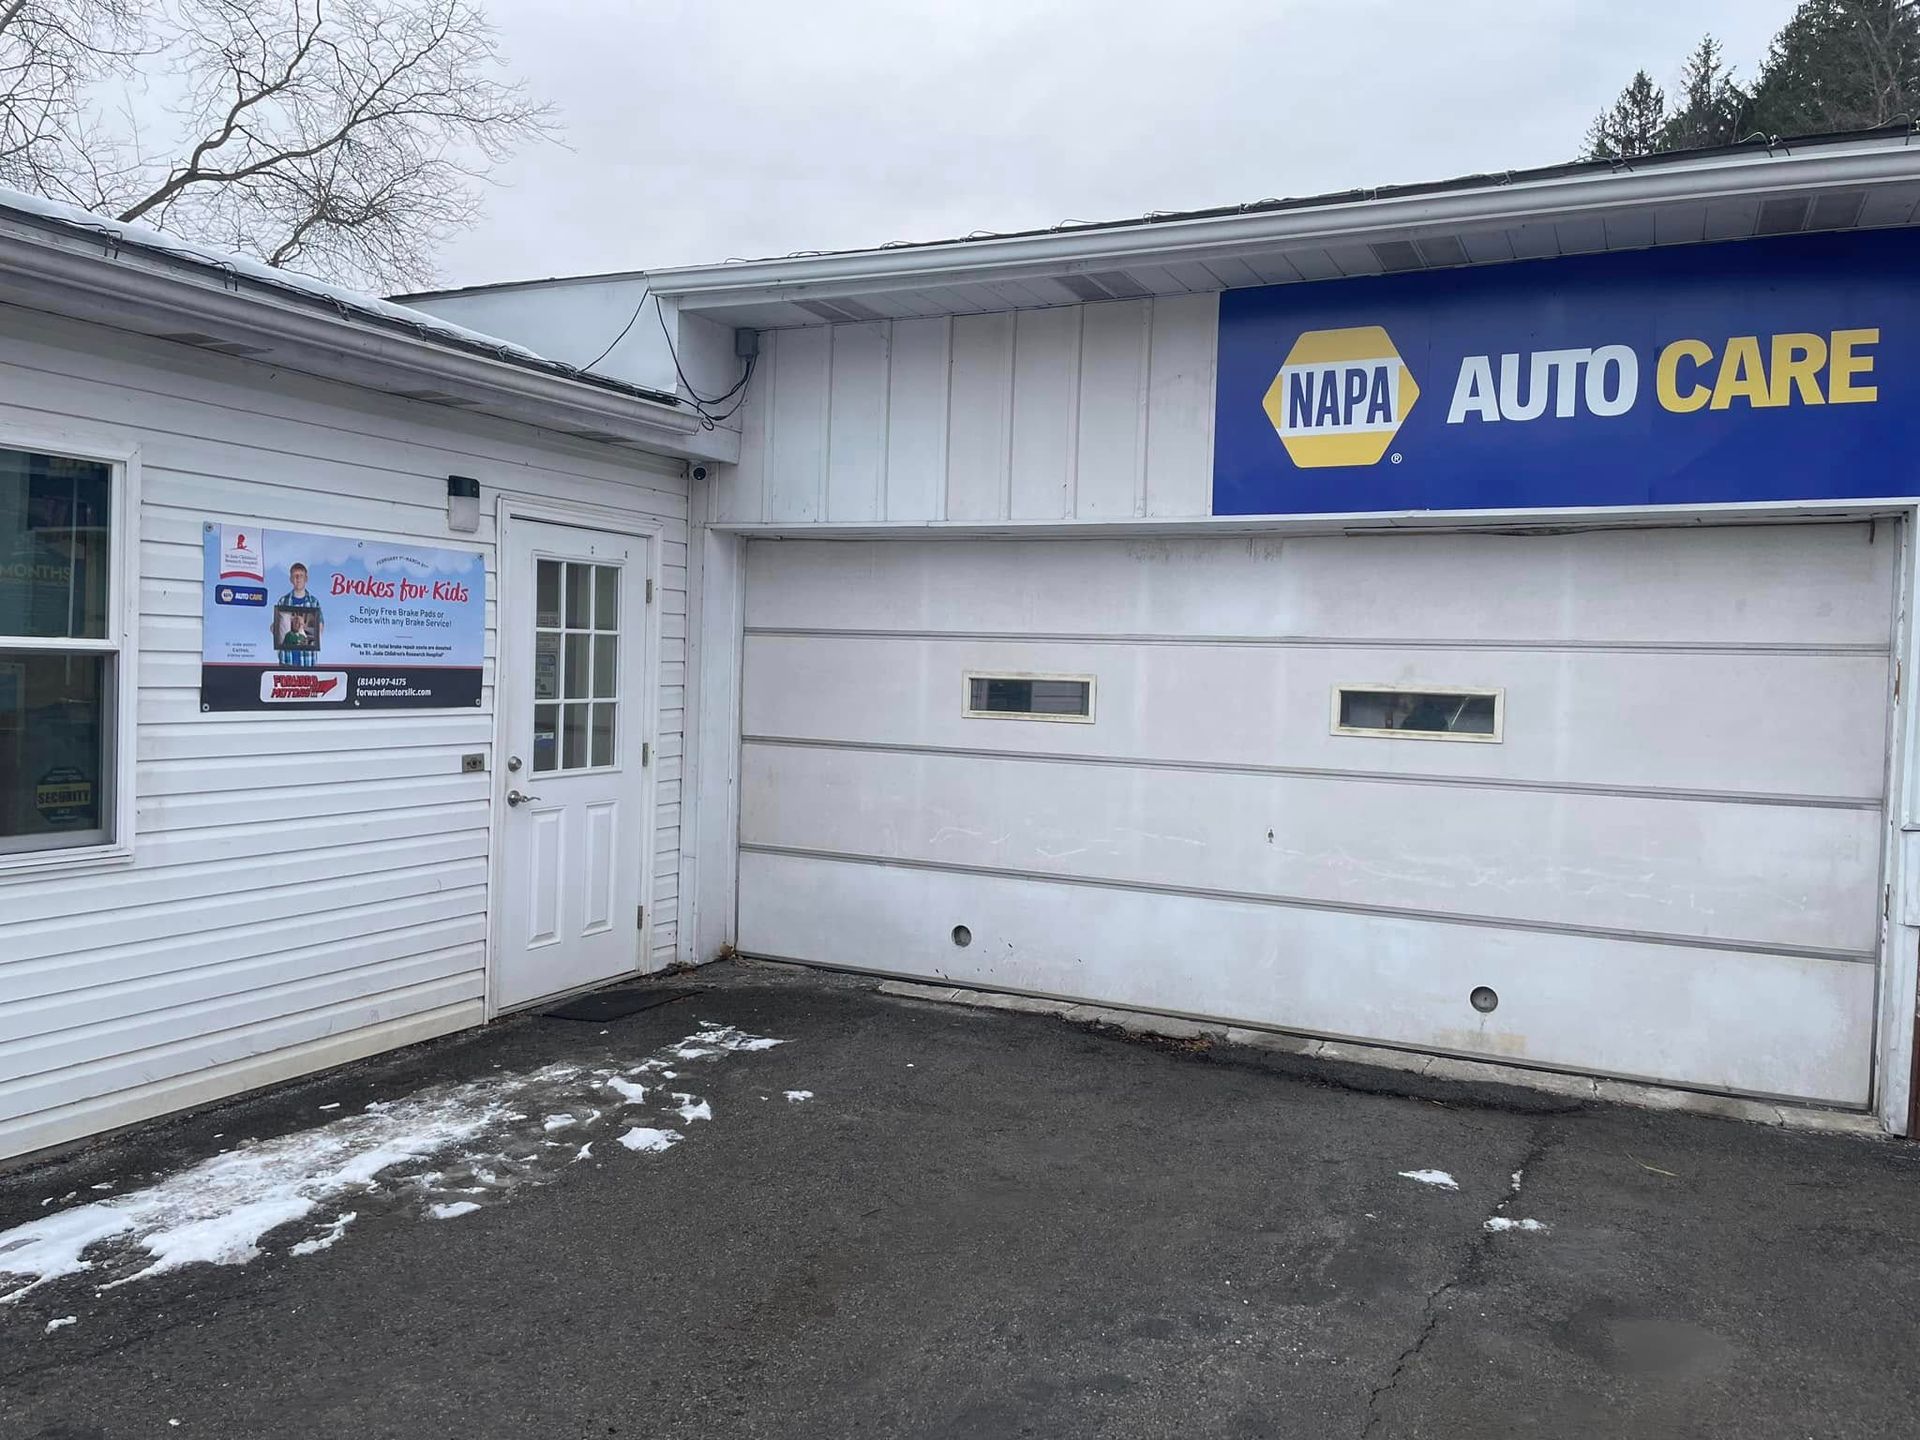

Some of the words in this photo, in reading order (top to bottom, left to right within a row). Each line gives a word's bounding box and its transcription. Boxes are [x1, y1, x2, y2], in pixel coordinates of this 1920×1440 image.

[1446, 344, 1638, 424] AUTO
[1655, 328, 1880, 413] CARE
[1289, 366, 1392, 428] NAPA
[330, 573, 396, 599] Brakes
[399, 577, 430, 602] for
[432, 580, 469, 603] Kids
[235, 592, 249, 600] AUTO
[359, 606, 379, 617] Enjoy
[380, 607, 397, 616] Free
[398, 608, 419, 617] Brake
[420, 609, 436, 618] Pads
[436, 611, 444, 619] or
[349, 615, 373, 624] Shoes
[373, 617, 390, 625] with
[391, 618, 404, 628] any
[405, 617, 425, 626] Brake
[426, 619, 452, 628] Service!
[357, 677, 407, 687] (814)497-4175
[356, 687, 432, 697] forwardmotorsllc.com
[37, 790, 90, 805] SECURITY
